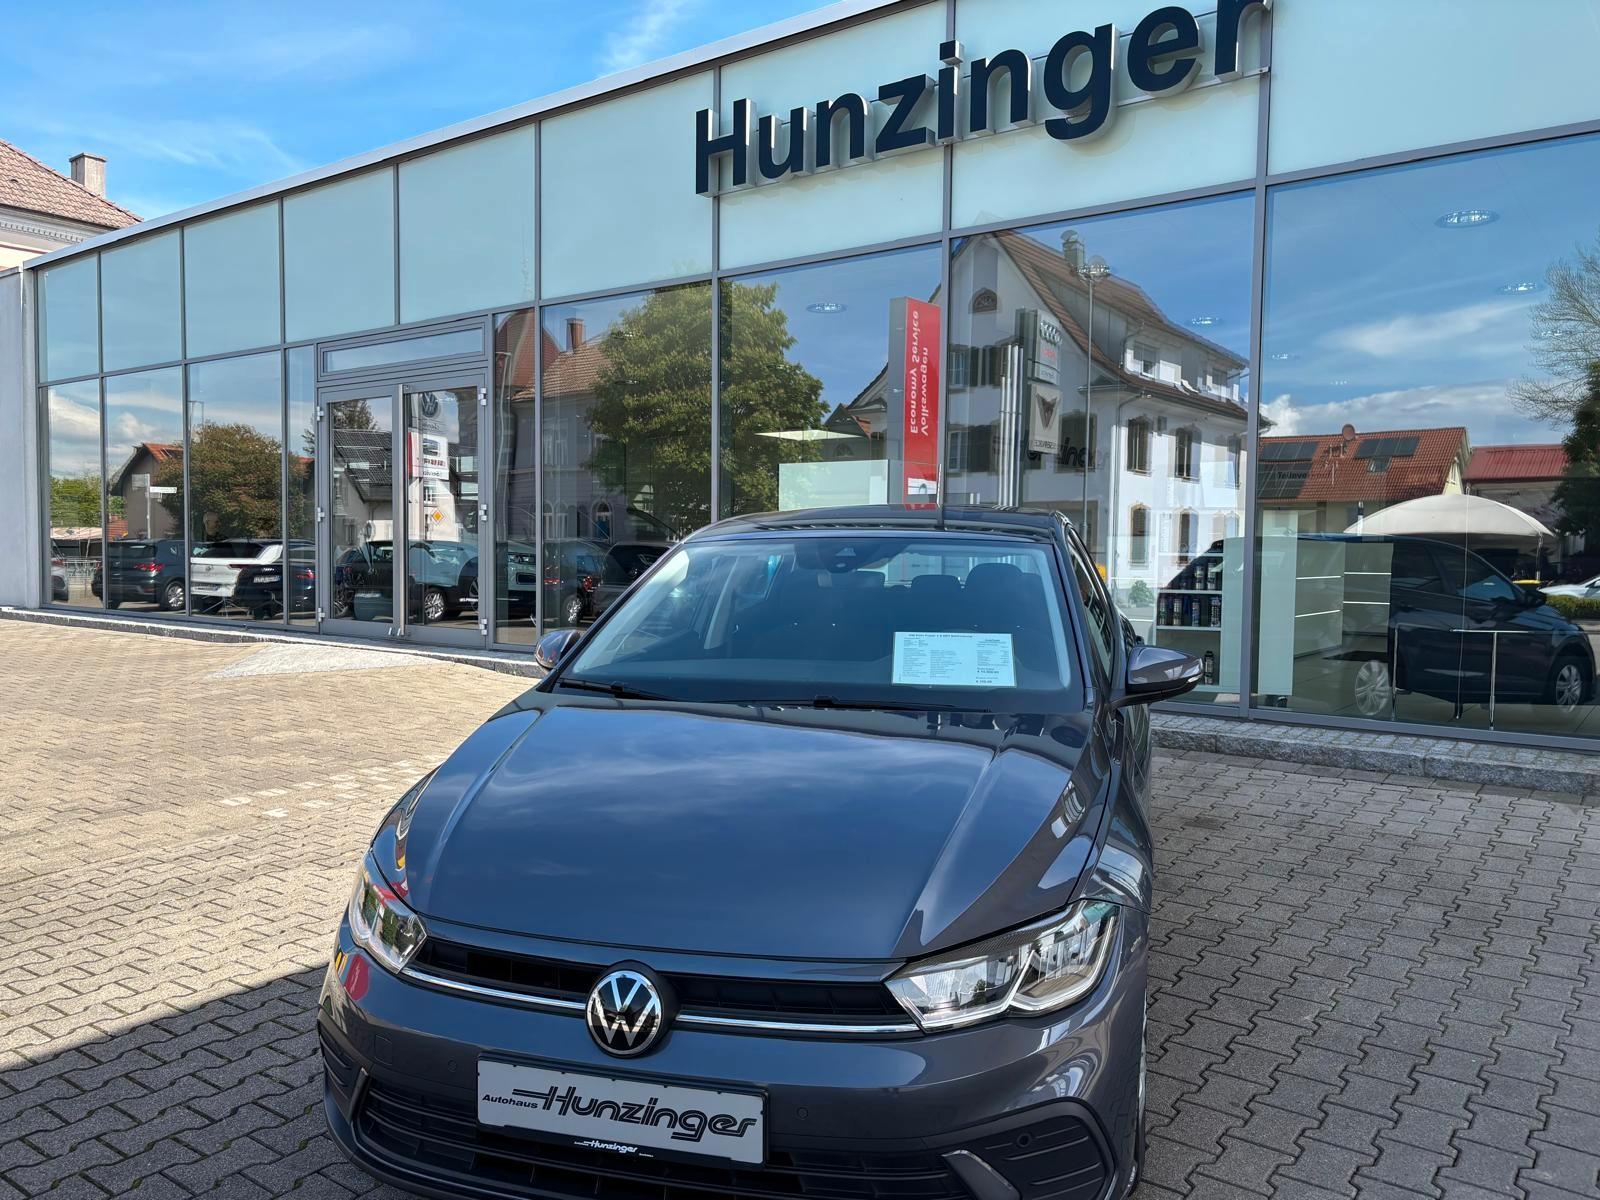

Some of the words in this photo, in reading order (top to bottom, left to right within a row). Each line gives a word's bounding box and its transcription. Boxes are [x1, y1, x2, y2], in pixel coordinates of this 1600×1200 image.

[696, 0, 1268, 196] Hunzinger
[482, 1094, 538, 1109] Autohaus
[512, 1086, 757, 1142] Hunzinger
[583, 1140, 638, 1154] Hunzinger
